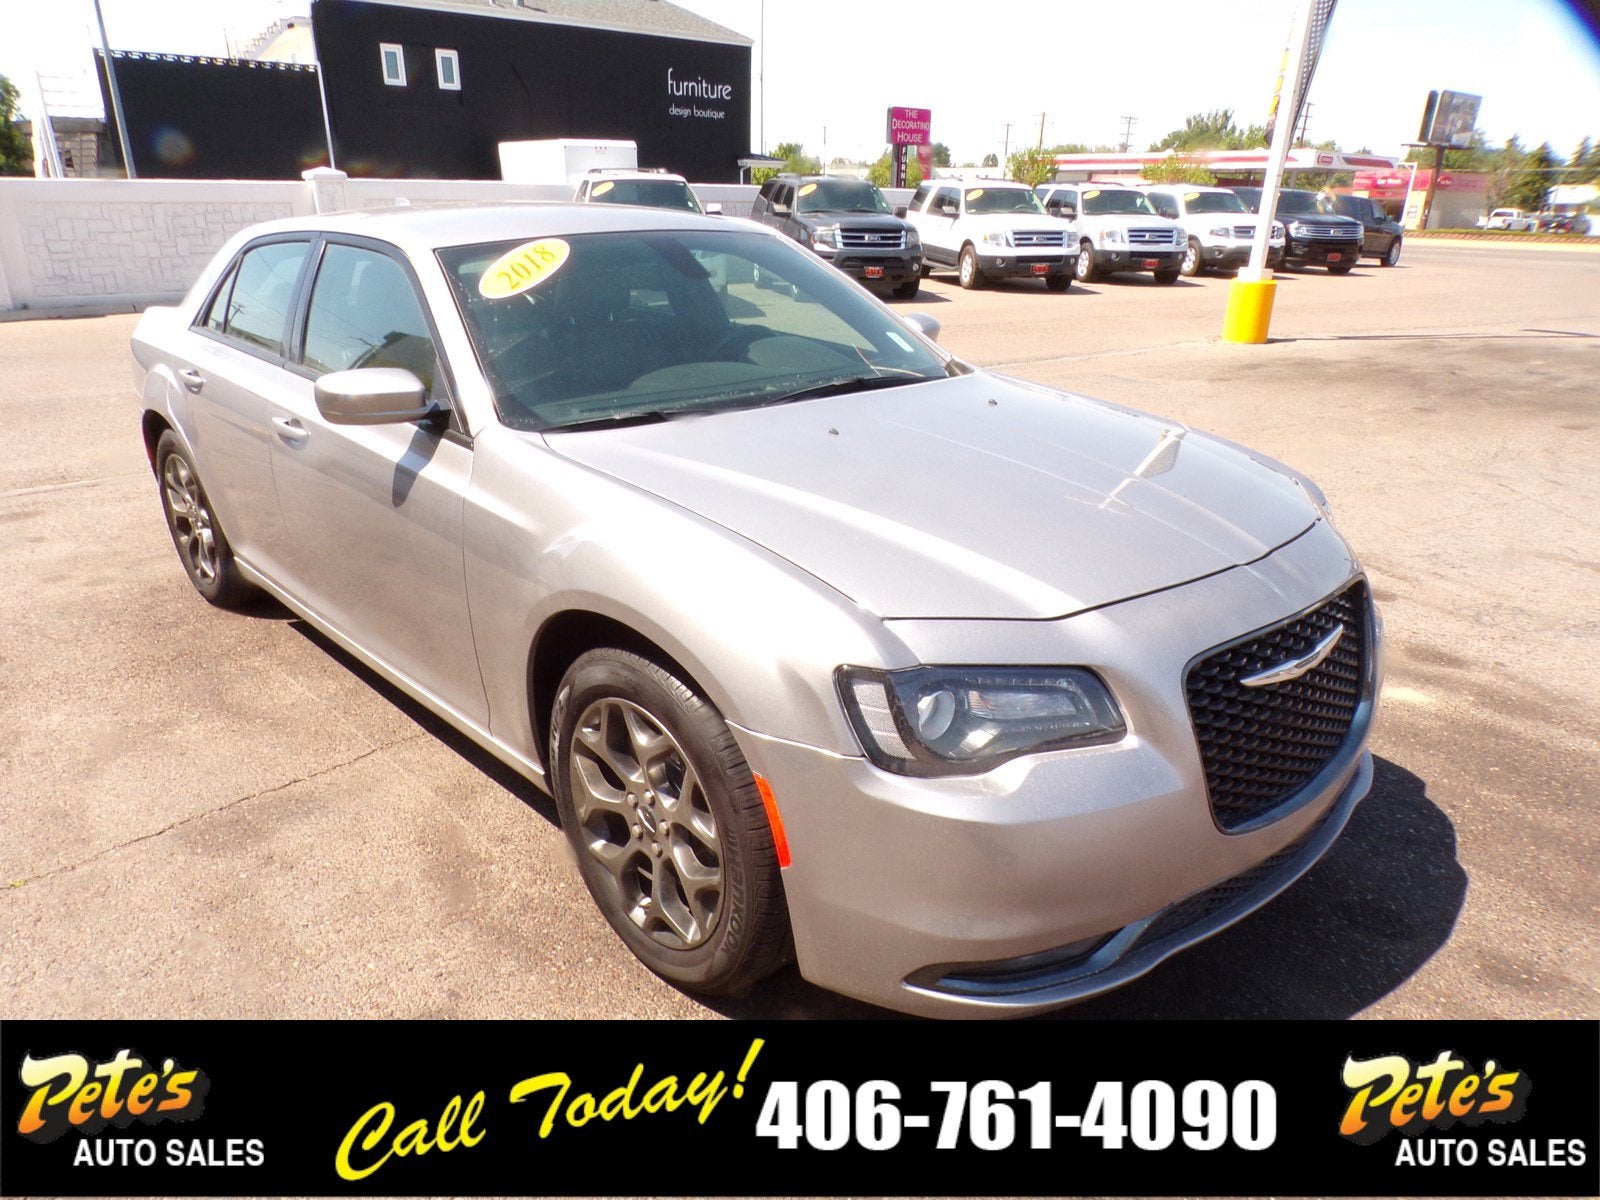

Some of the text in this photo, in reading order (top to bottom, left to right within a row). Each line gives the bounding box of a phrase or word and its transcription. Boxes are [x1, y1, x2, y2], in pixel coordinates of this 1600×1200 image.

[668, 67, 732, 100] furniture
[669, 102, 726, 120] design boutique
[905, 109, 918, 119] THE
[892, 118, 930, 131] DECORATING
[897, 131, 923, 143] HOUSE
[497, 244, 555, 290] 2018
